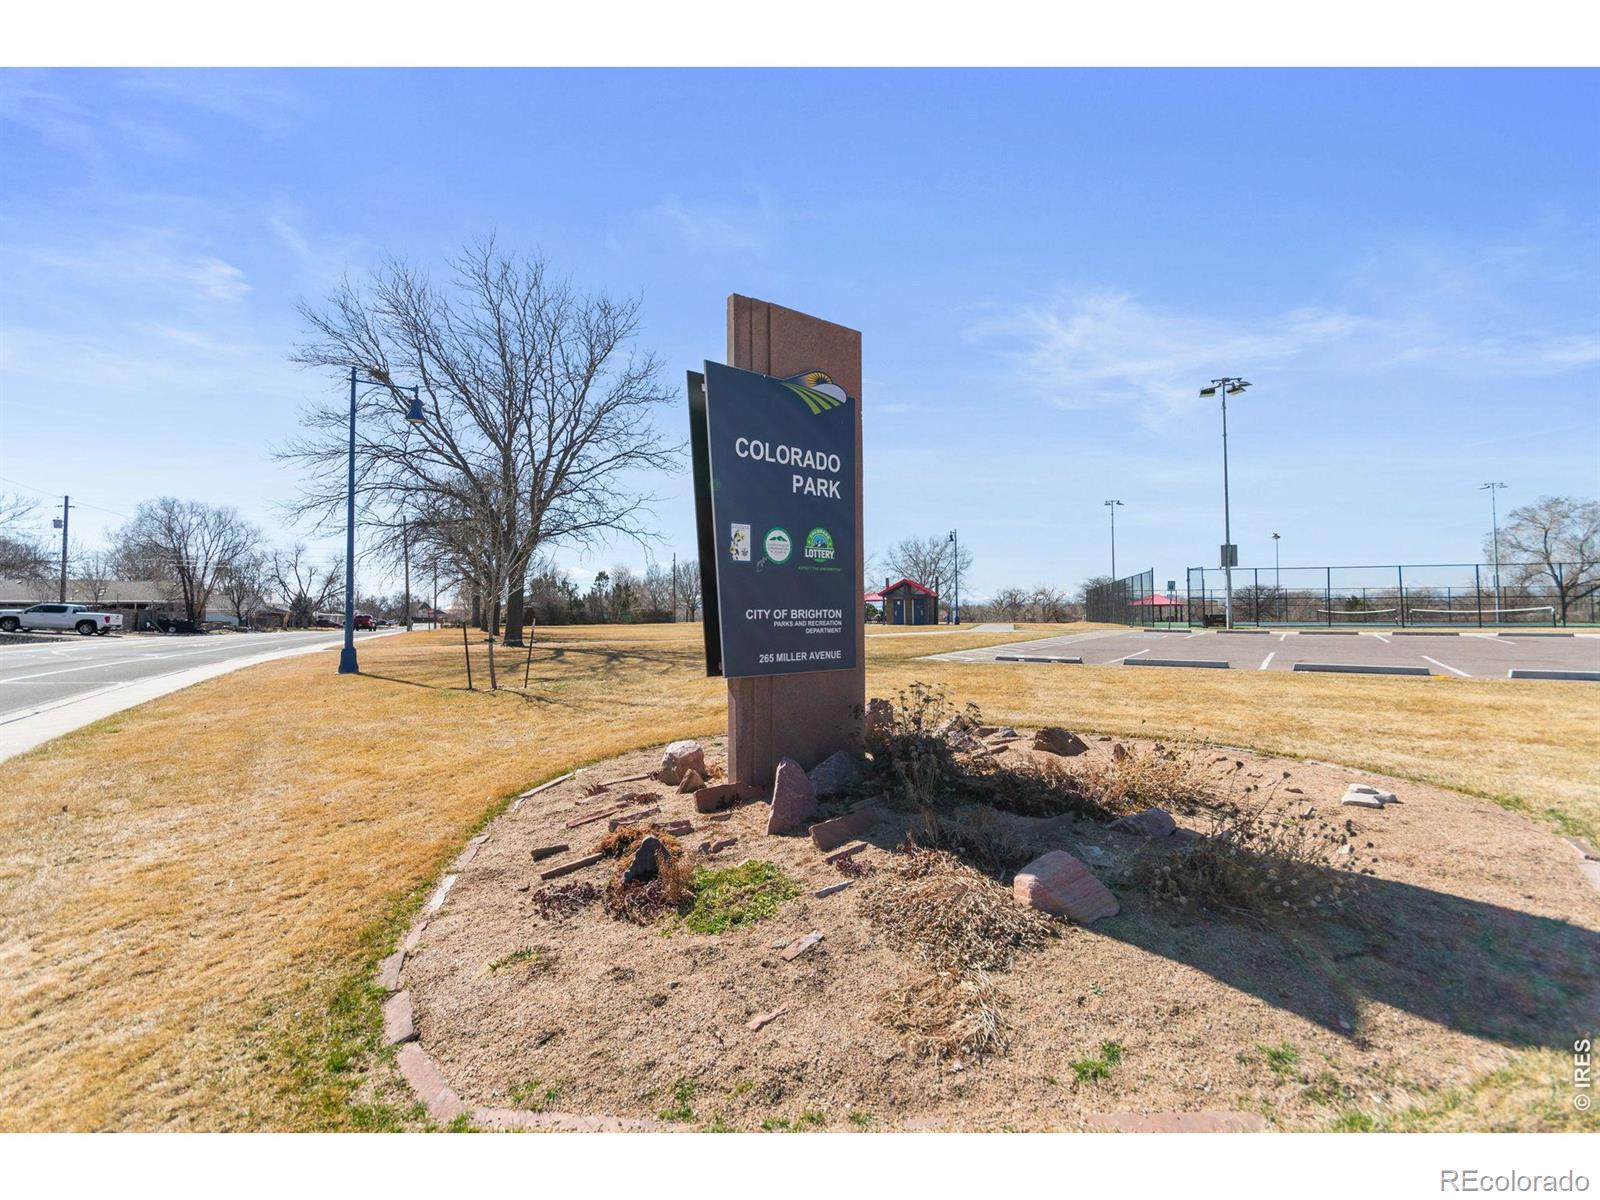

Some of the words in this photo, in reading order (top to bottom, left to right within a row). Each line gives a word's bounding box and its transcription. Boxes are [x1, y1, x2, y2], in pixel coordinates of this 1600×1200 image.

[735, 437, 841, 473] COLORADO
[792, 474, 841, 499] PARK
[804, 548, 835, 560] LOTTERY
[745, 609, 771, 620] CITY
[773, 609, 788, 619] OF
[790, 609, 842, 619] BRIGHTON
[759, 653, 774, 663] 265
[776, 652, 807, 662] MILLER
[809, 650, 841, 660] AVENUE
